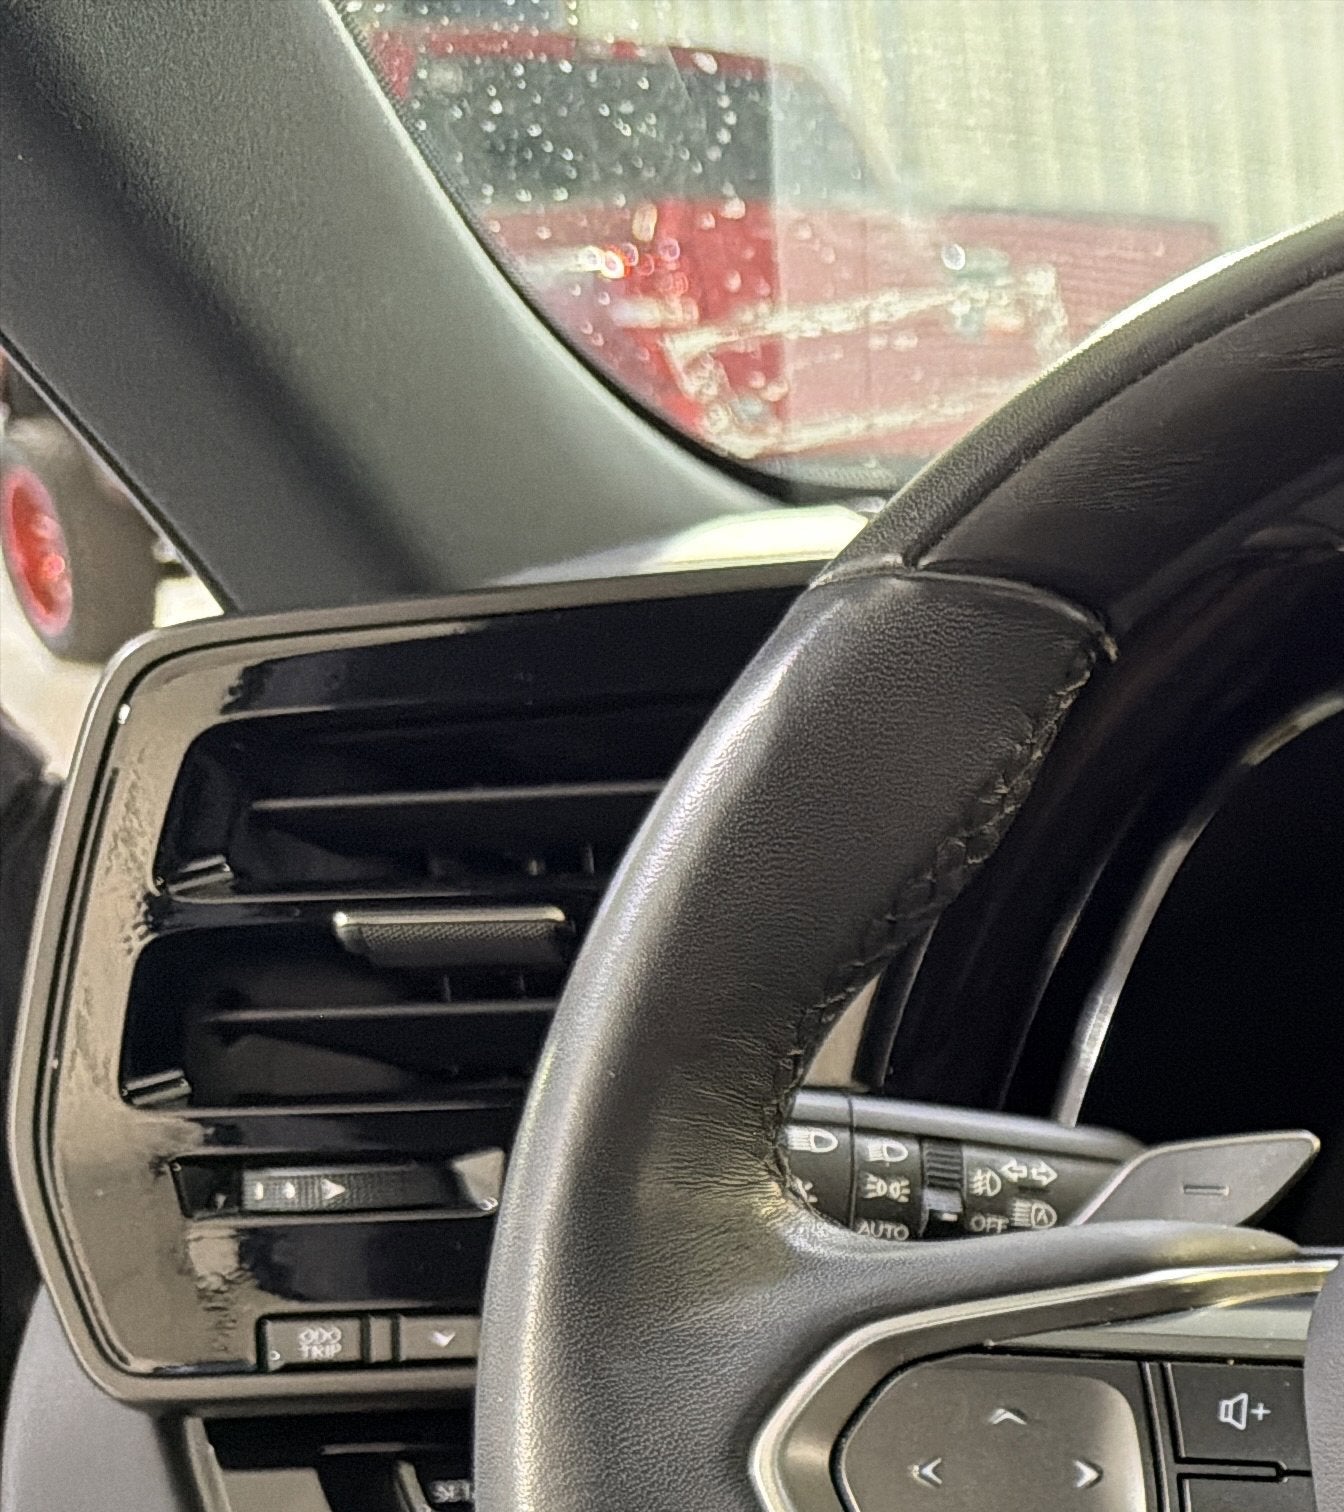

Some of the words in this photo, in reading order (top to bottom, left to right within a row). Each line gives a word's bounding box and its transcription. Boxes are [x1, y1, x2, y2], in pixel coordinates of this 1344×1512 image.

[856, 1218, 910, 1241] AUTO
[969, 1213, 1010, 1233] OFF
[299, 1343, 342, 1360] TRIP
